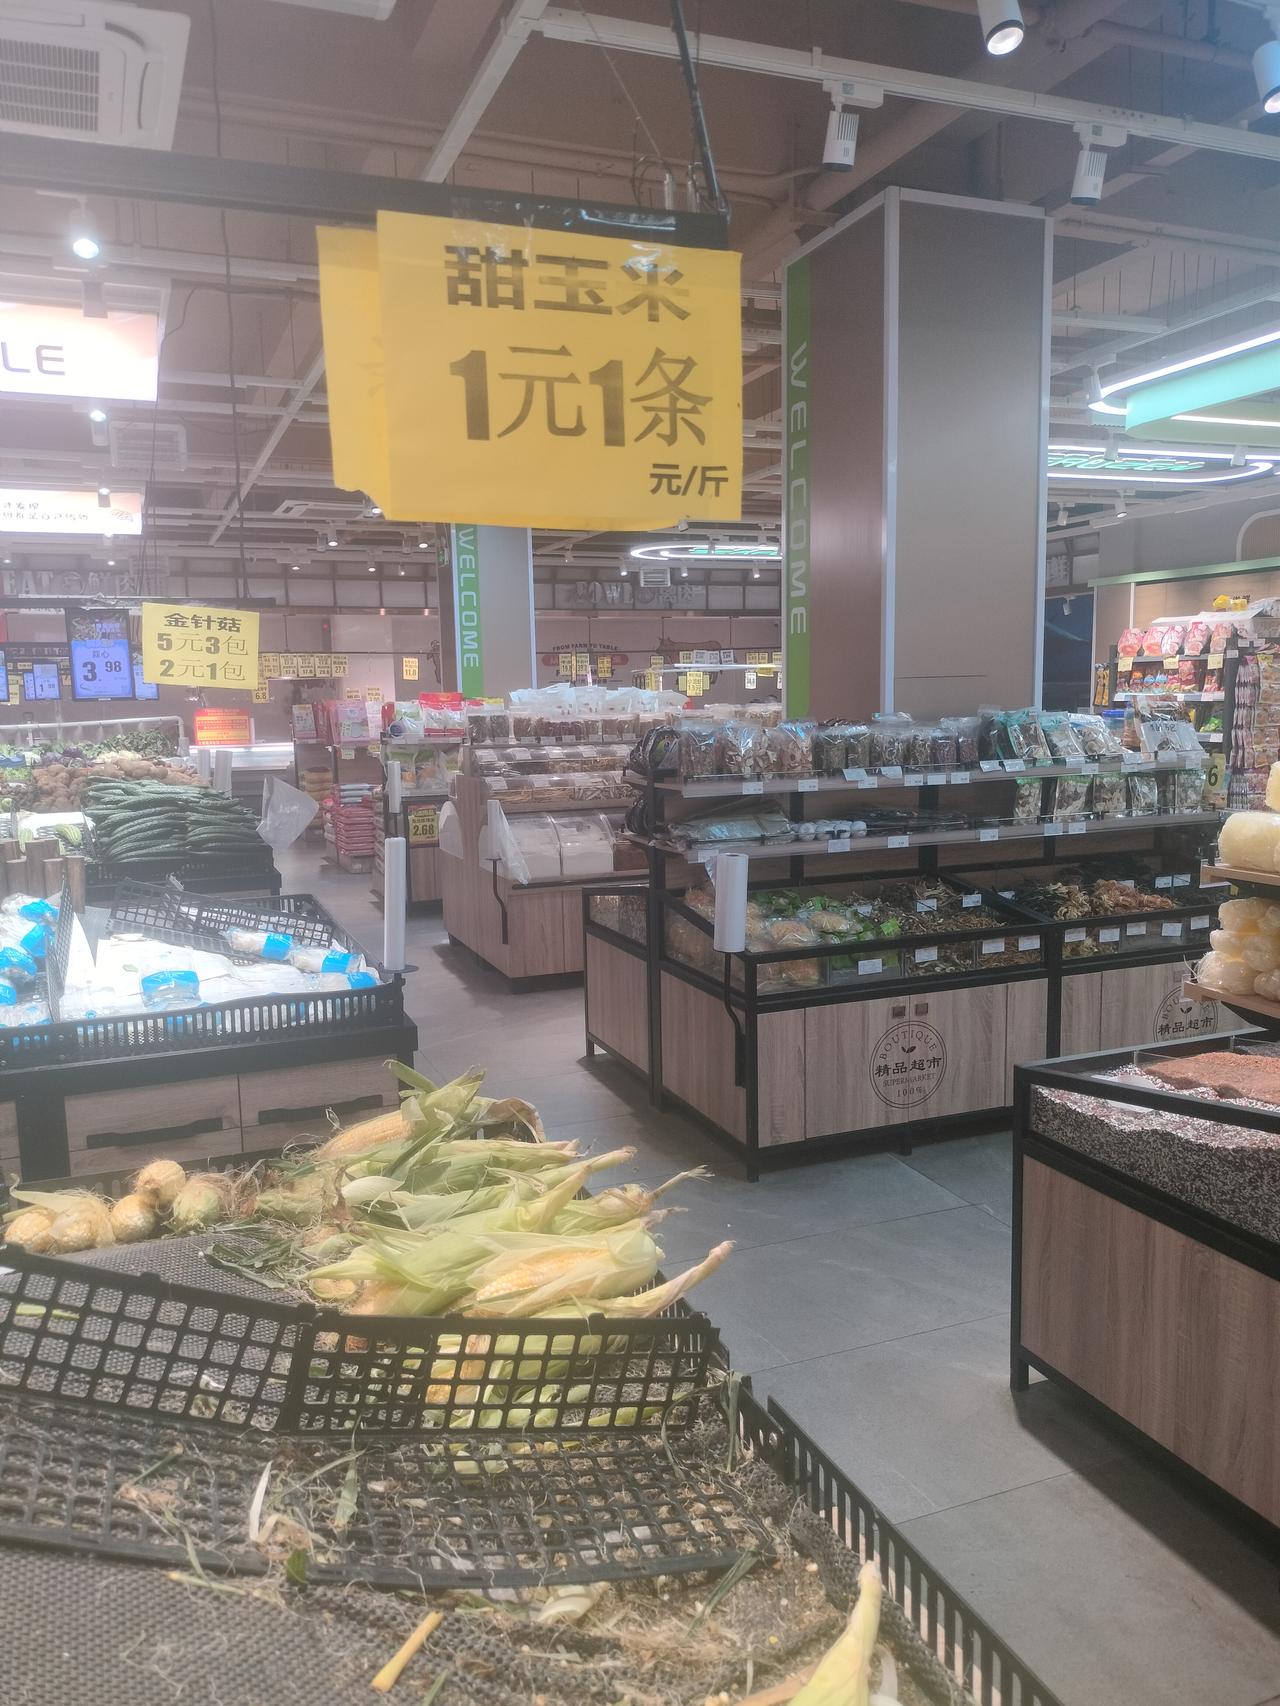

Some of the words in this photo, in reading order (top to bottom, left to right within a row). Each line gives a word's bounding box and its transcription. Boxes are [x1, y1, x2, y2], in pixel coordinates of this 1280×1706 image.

[444, 245, 691, 322] 甜玉米
[449, 345, 713, 447] 1元1条
[650, 463, 729, 497] 元/斤
[789, 342, 807, 636] WELCOME
[459, 528, 479, 667] WELCOME
[164, 612, 242, 633] 金针菇
[157, 632, 249, 656] 5元3包
[159, 659, 246, 681] 2元1包
[413, 824, 435, 836] 2.68
[1158, 1017, 1214, 1036] 精品超市
[879, 1029, 938, 1060] BOUTIQUE
[874, 1056, 942, 1078] 精品超市
